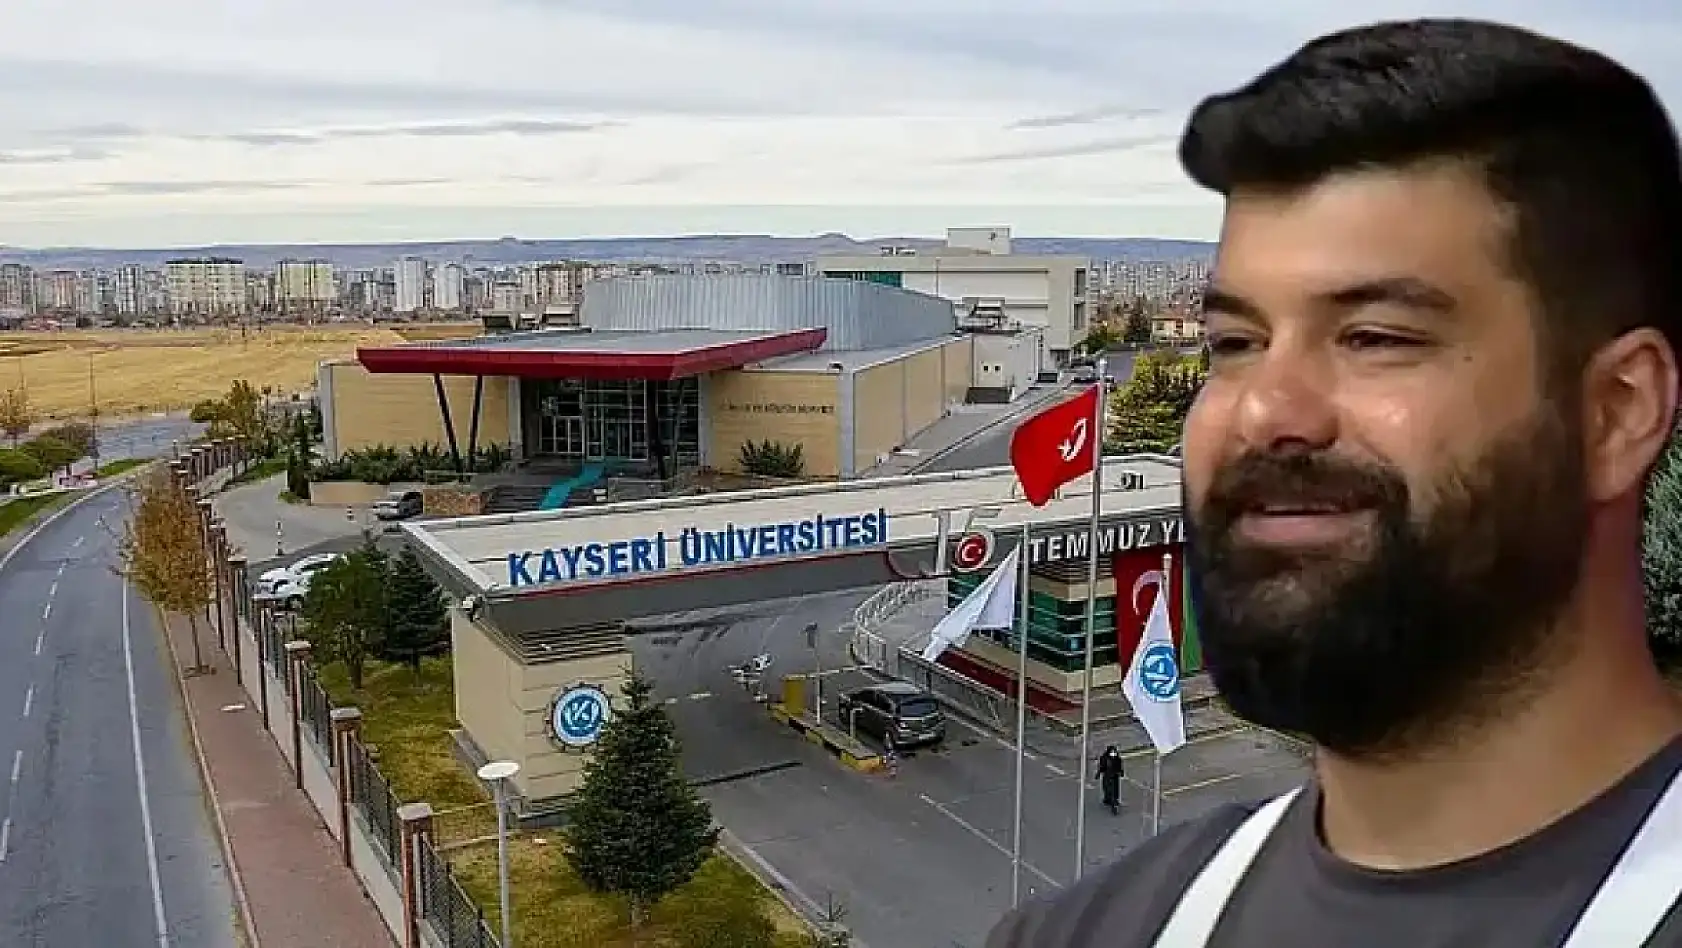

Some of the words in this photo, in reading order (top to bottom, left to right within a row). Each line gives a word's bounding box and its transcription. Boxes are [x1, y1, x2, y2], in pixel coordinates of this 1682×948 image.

[508, 532, 667, 586] KAYSERİ
[681, 508, 889, 565] ÜNİVERSİTESİ
[1030, 524, 1153, 563] TEMMUZ
